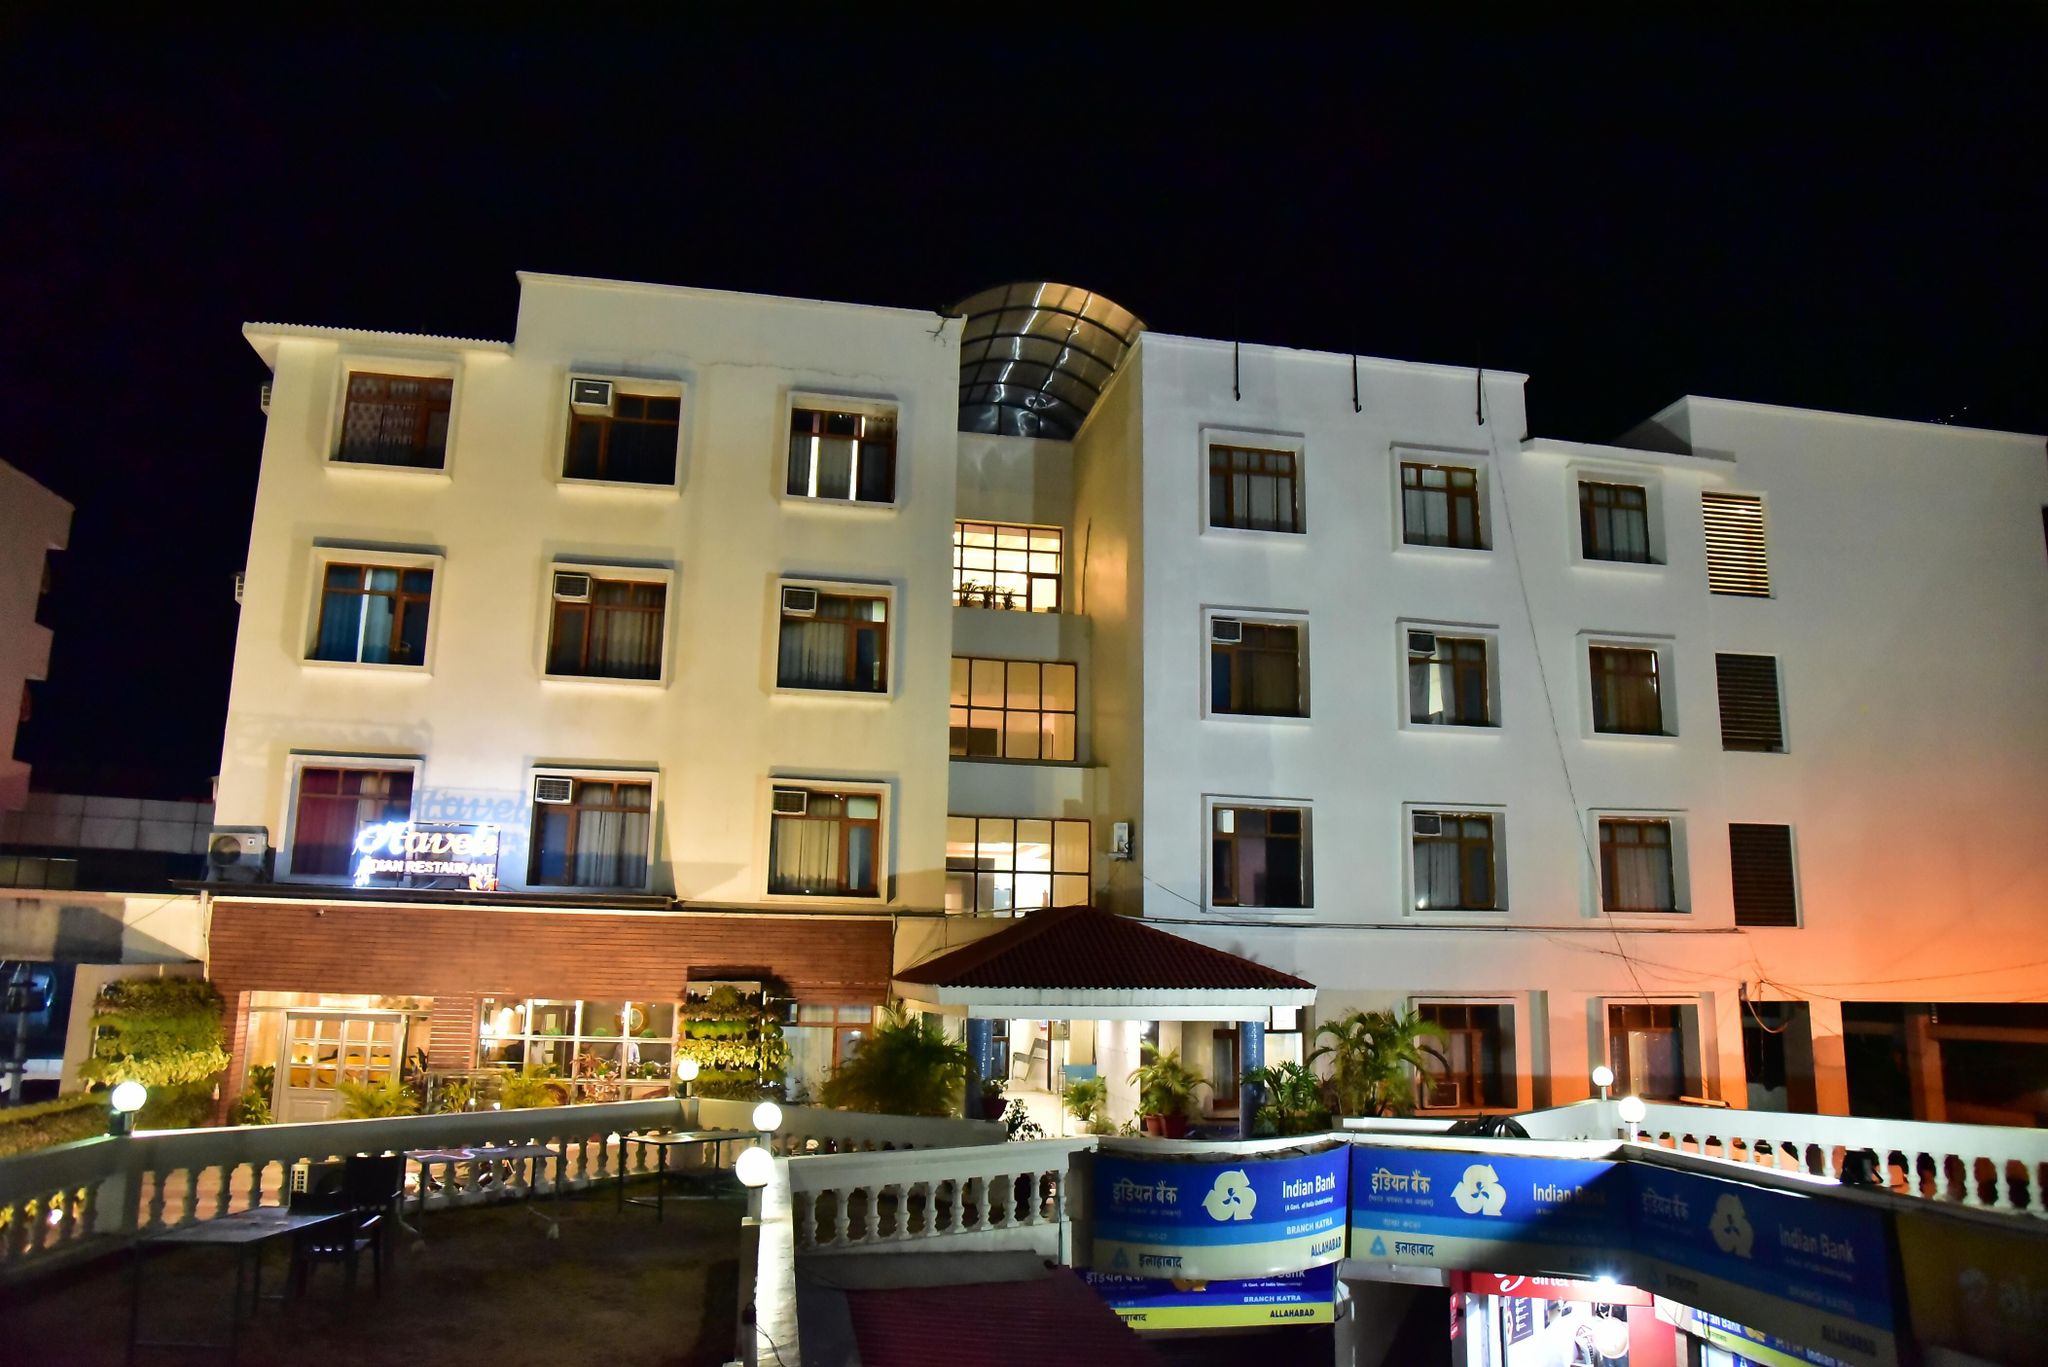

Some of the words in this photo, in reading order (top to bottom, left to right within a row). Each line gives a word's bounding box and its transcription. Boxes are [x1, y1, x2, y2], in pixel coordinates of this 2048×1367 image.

[405, 861, 496, 878] RESTAURANT
[1282, 1179, 1314, 1199] Indian
[1315, 1172, 1336, 1193] Bank
[1371, 1166, 1410, 1194] इंडियन
[1410, 1168, 1431, 1194] बैंक
[1532, 1182, 1572, 1203] Indian
[1286, 1222, 1314, 1235] BRANCH
[1315, 1216, 1333, 1230] KATRA
[1311, 1236, 1342, 1257] ALLAHABAD
[1394, 1241, 1435, 1257] इलाहाबाद
[1778, 1222, 1818, 1253] Indian
[1819, 1232, 1856, 1264] Bank
[1138, 1253, 1183, 1269] इलाहाबाद
[1276, 1294, 1302, 1302] KATRA
[1269, 1308, 1315, 1318] ALLAHABAD
